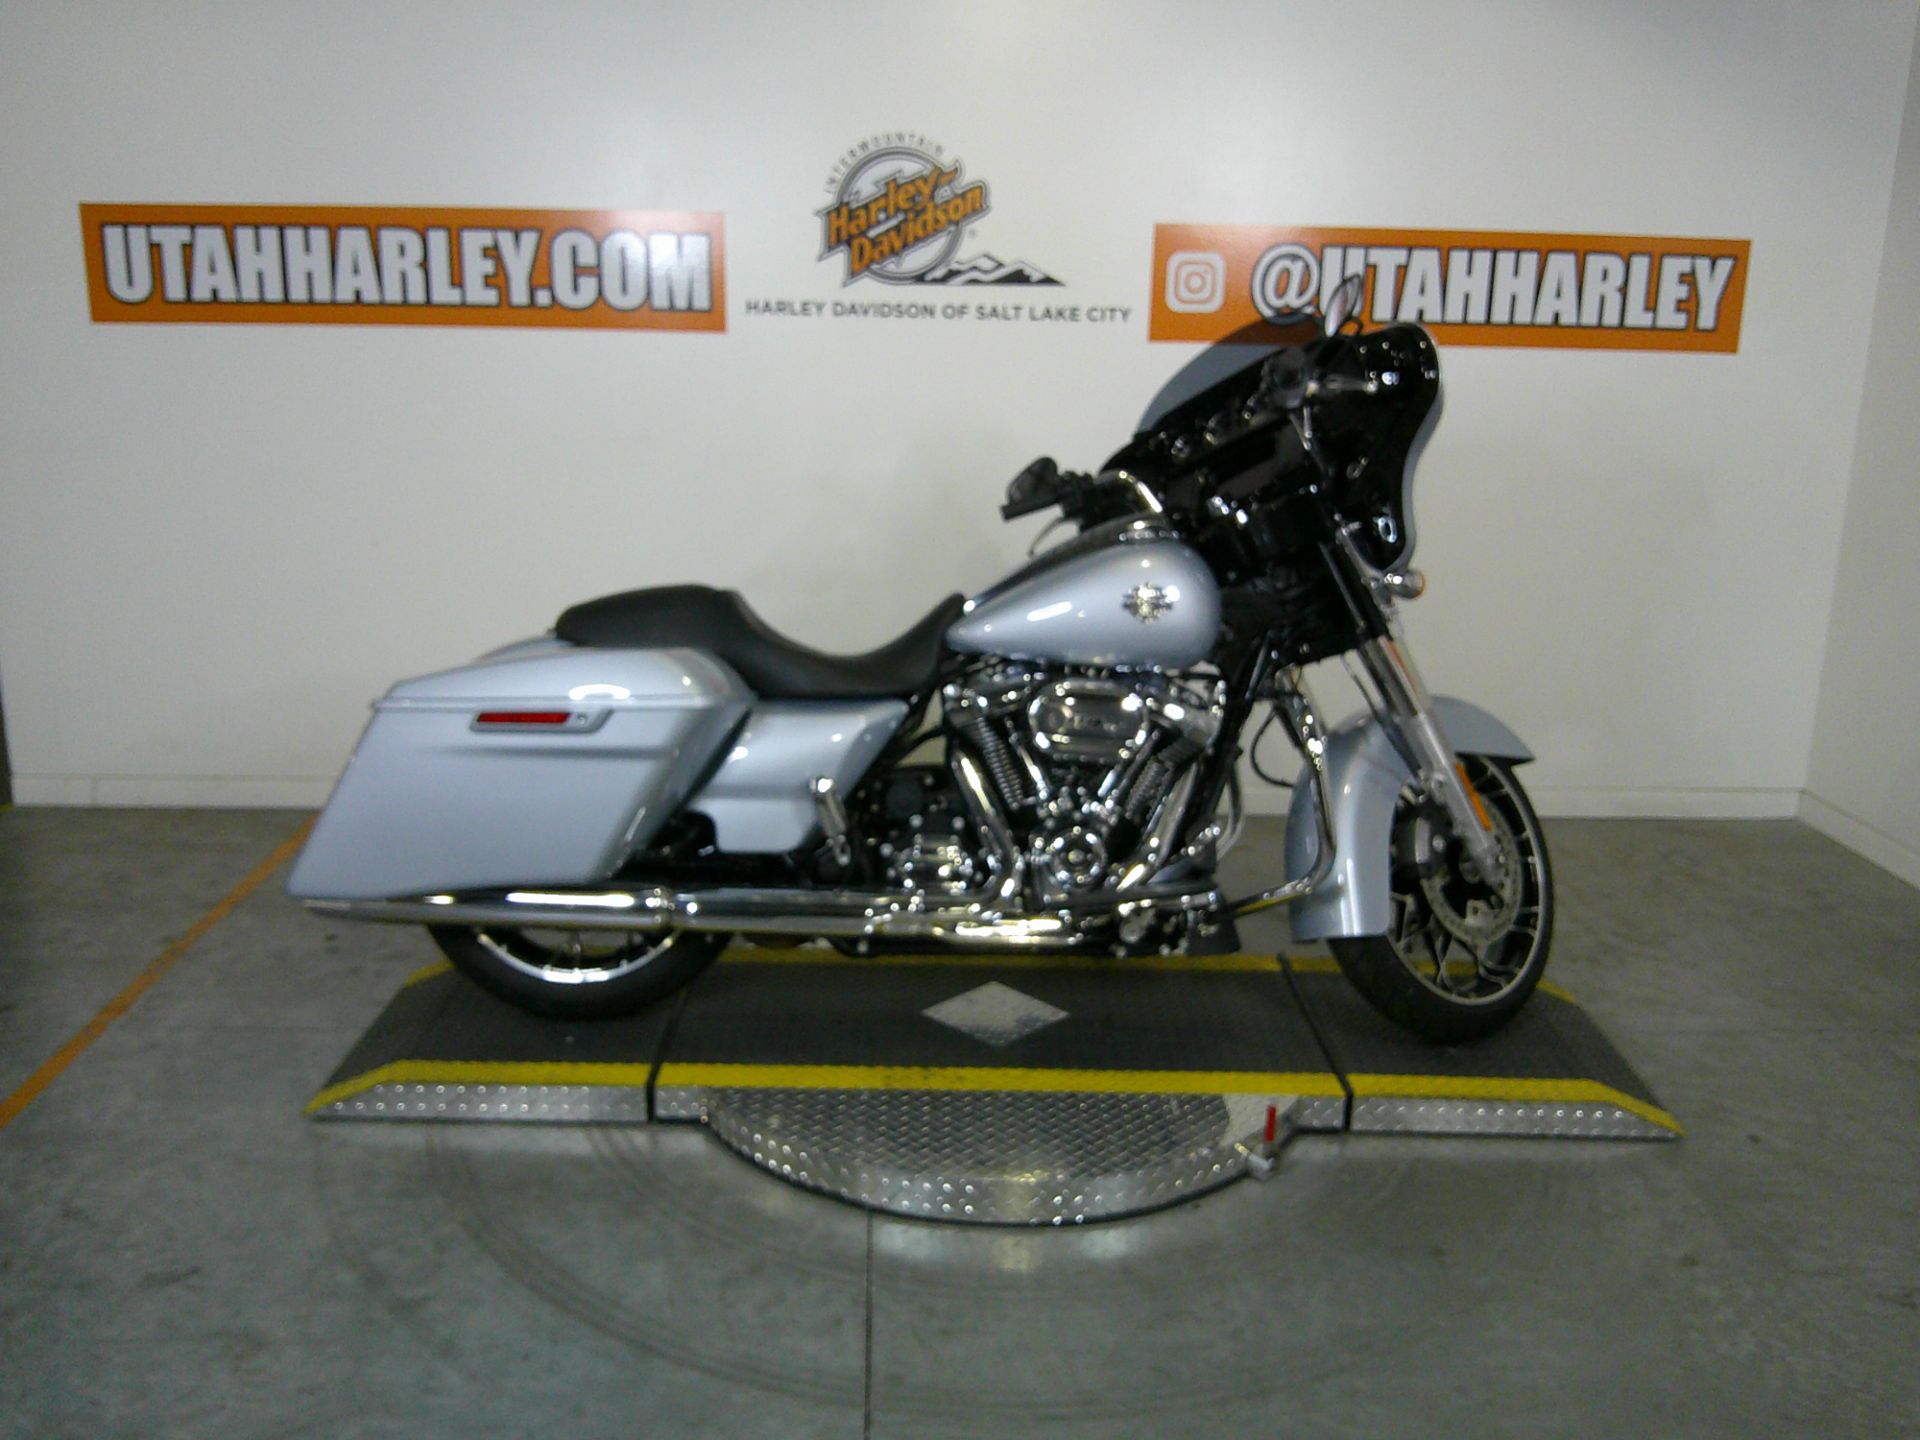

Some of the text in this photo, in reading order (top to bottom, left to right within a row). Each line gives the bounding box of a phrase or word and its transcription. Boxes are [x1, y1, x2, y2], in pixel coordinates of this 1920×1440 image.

[101, 222, 712, 312] UTAHHARLEY.COM
[850, 184, 985, 274] Davidson
[745, 301, 1131, 323] HARLEY DAVIDSON OF SALT LAKE CITY
[1250, 242, 1736, 331] @UTAHHARLEY
